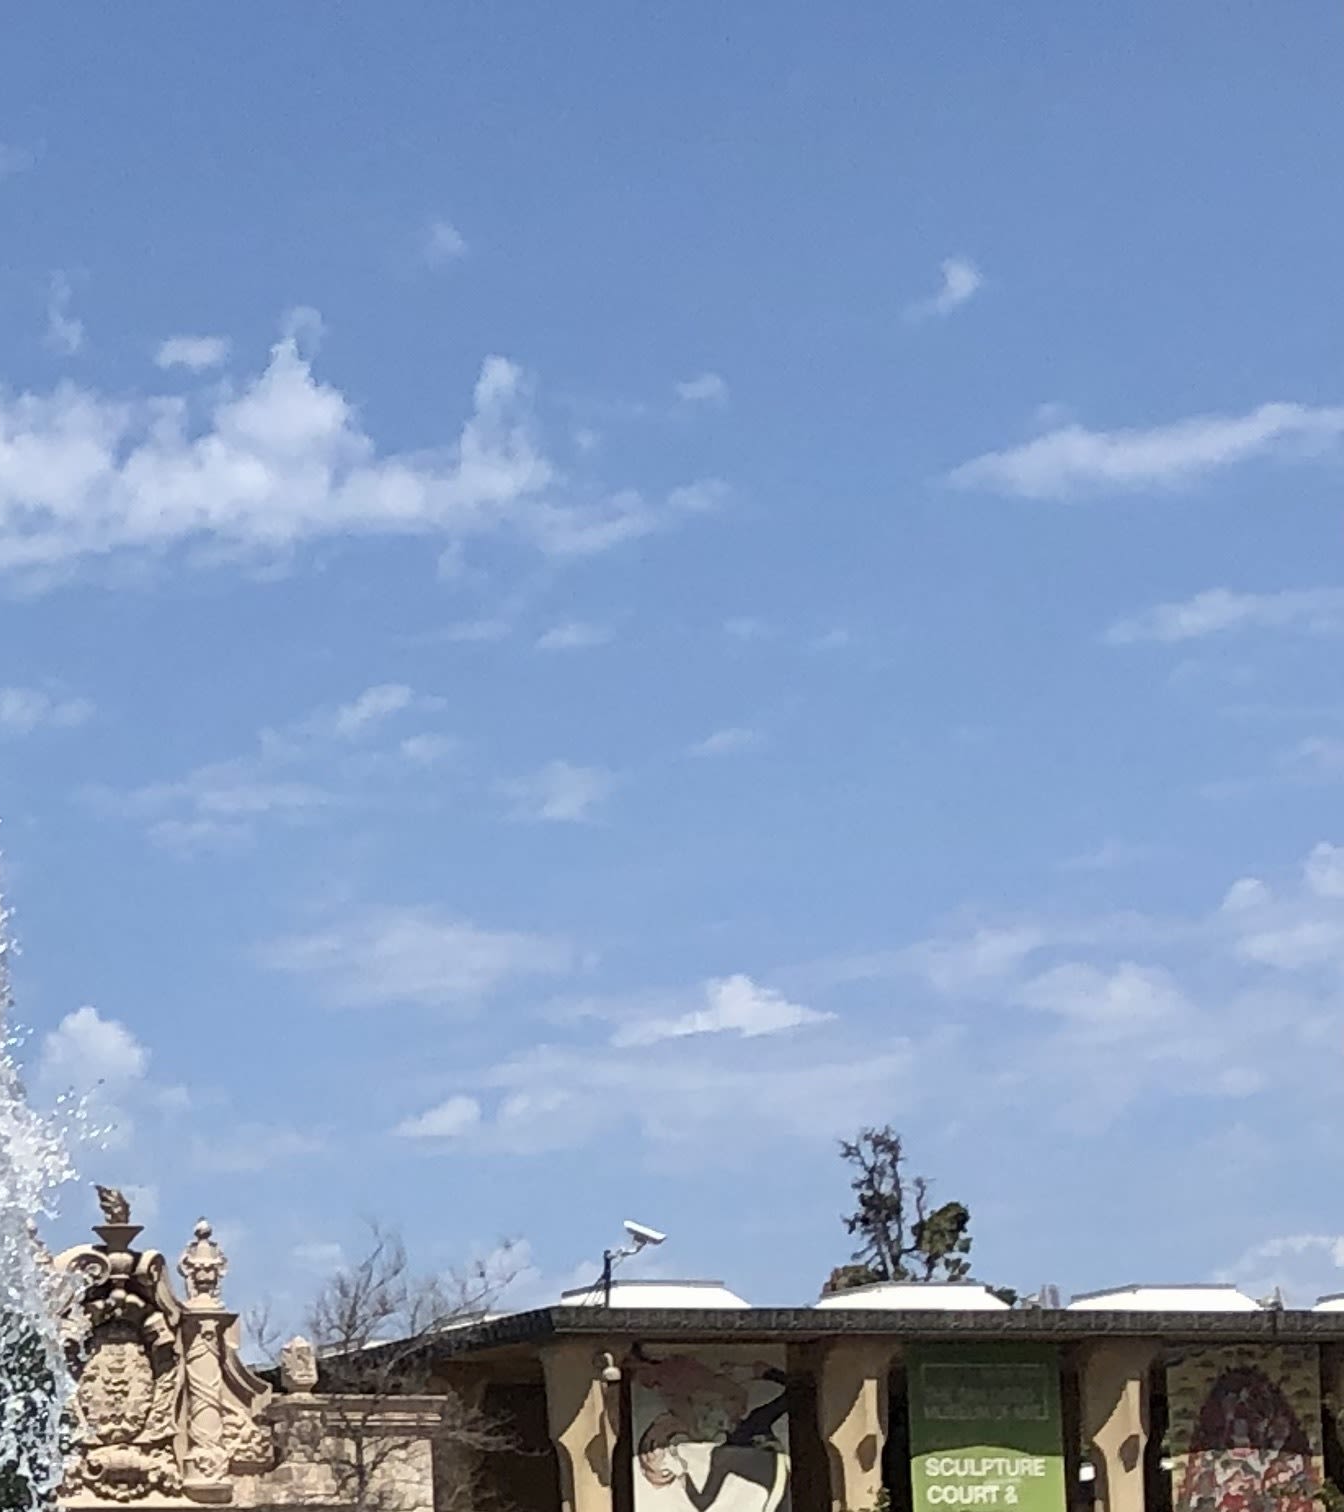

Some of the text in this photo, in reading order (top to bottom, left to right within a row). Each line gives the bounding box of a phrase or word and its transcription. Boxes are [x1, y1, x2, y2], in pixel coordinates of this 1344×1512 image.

[925, 1457, 1045, 1477] SCULPTURE
[927, 1485, 1018, 1504] COURT &
